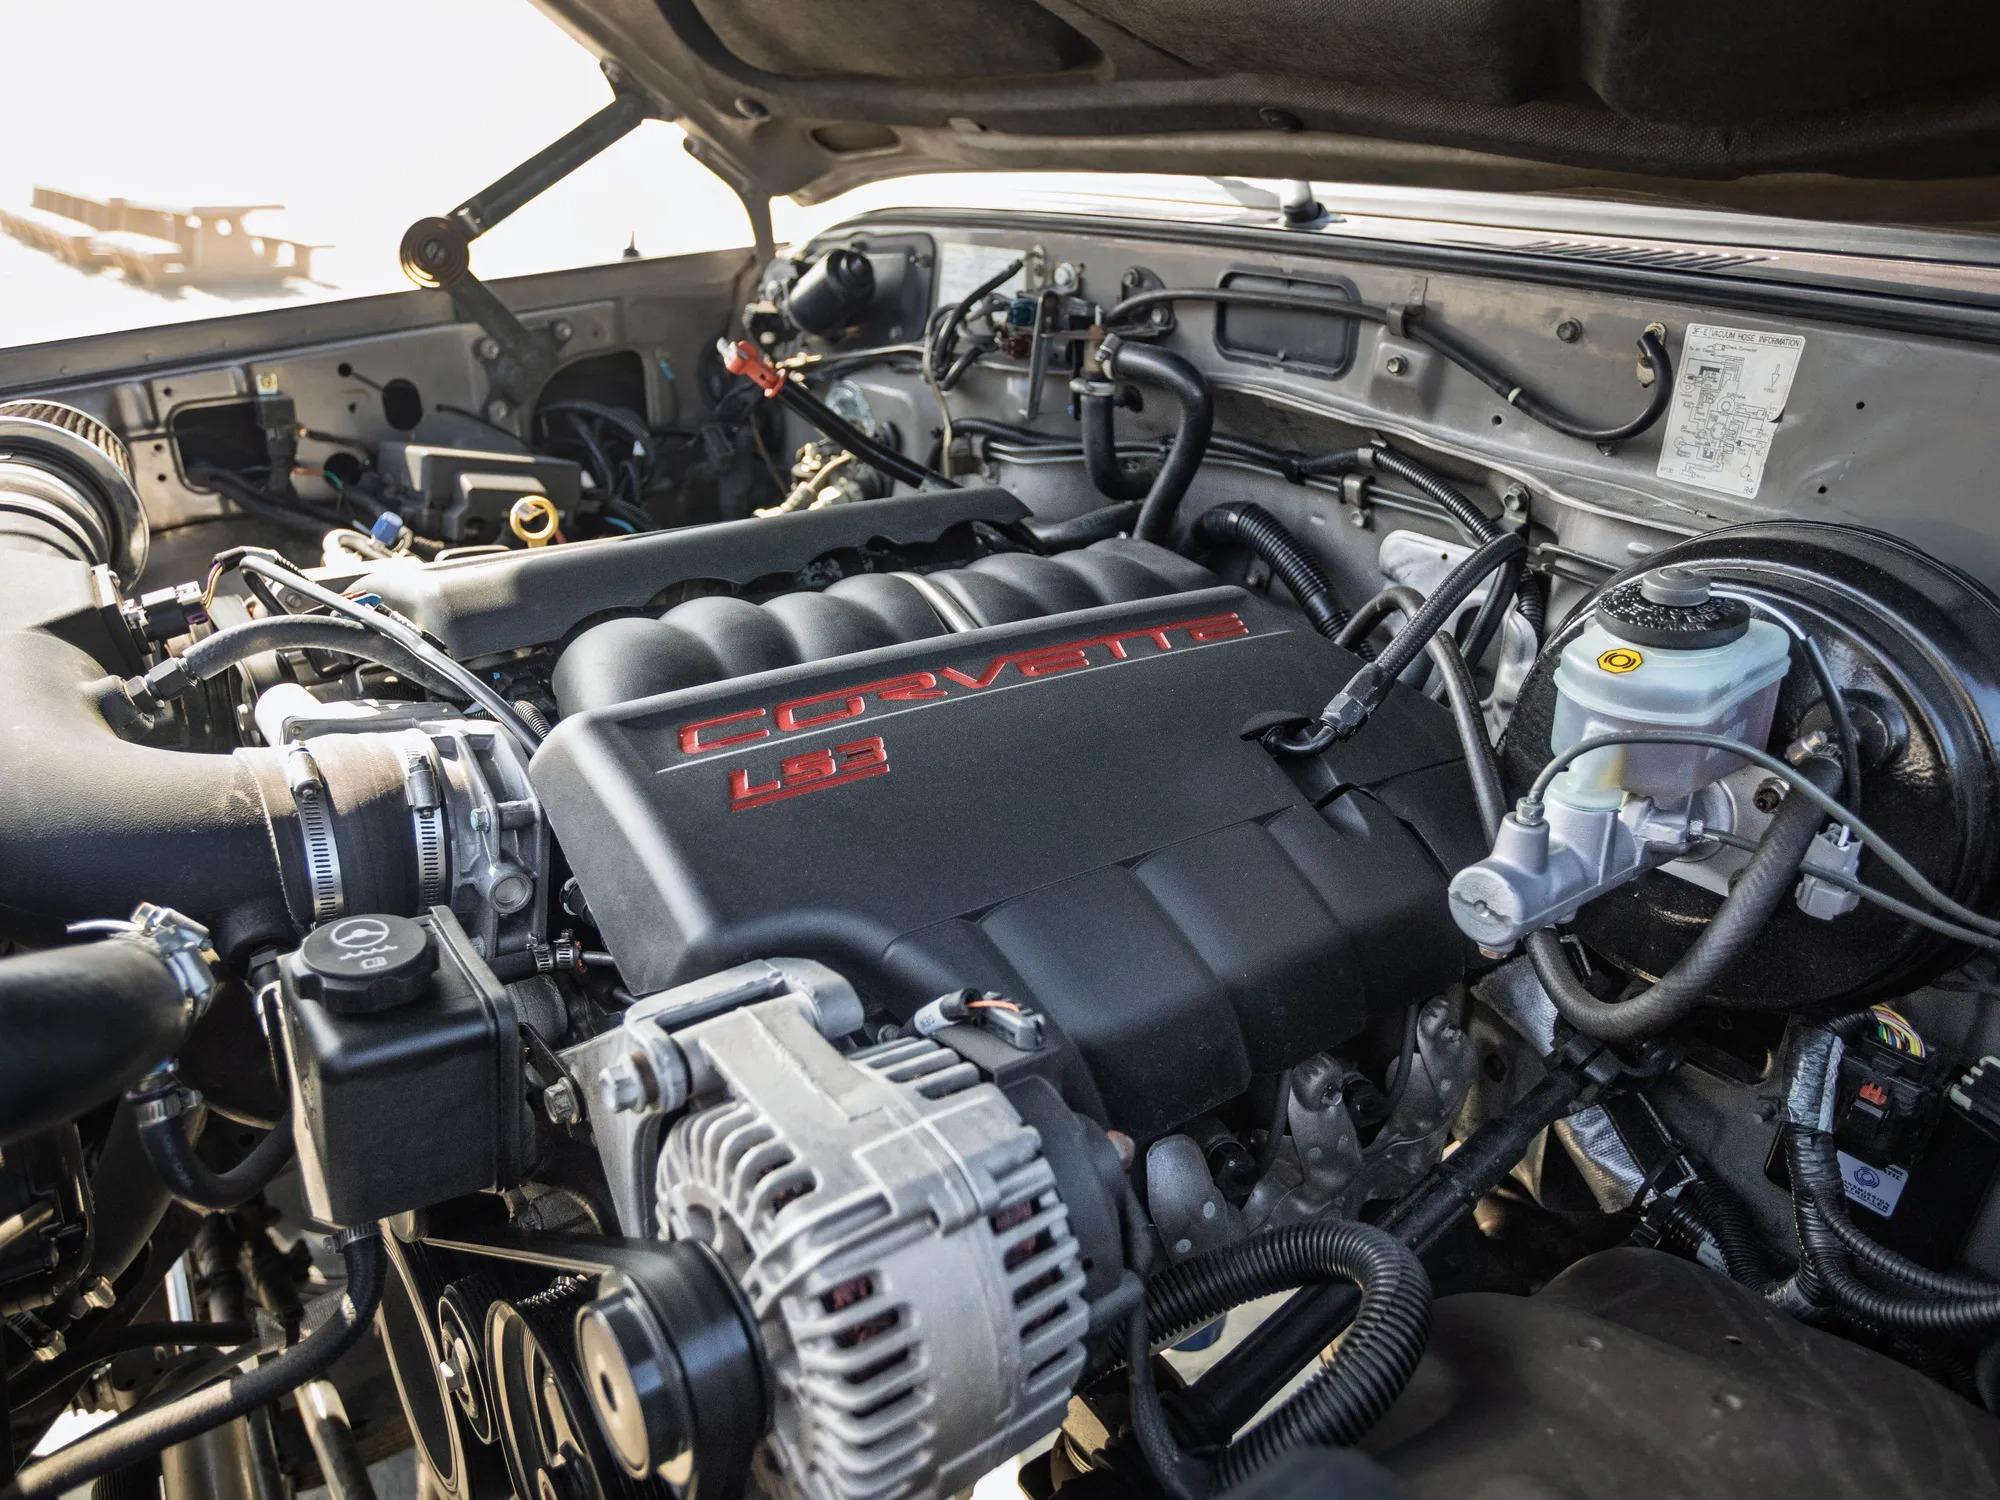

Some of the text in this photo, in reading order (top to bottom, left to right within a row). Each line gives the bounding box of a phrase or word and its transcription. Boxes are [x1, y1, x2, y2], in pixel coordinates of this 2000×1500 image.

[1711, 328, 1736, 340] VACUUM
[1738, 332, 1756, 342] HOSE
[1758, 335, 1800, 348] INFORMATION
[679, 611, 1250, 755] CORVETTE
[729, 736, 888, 801] LS3
[1844, 1179, 1890, 1207] ANSMISSION
[1844, 1184, 1889, 1211] NTROLLER
